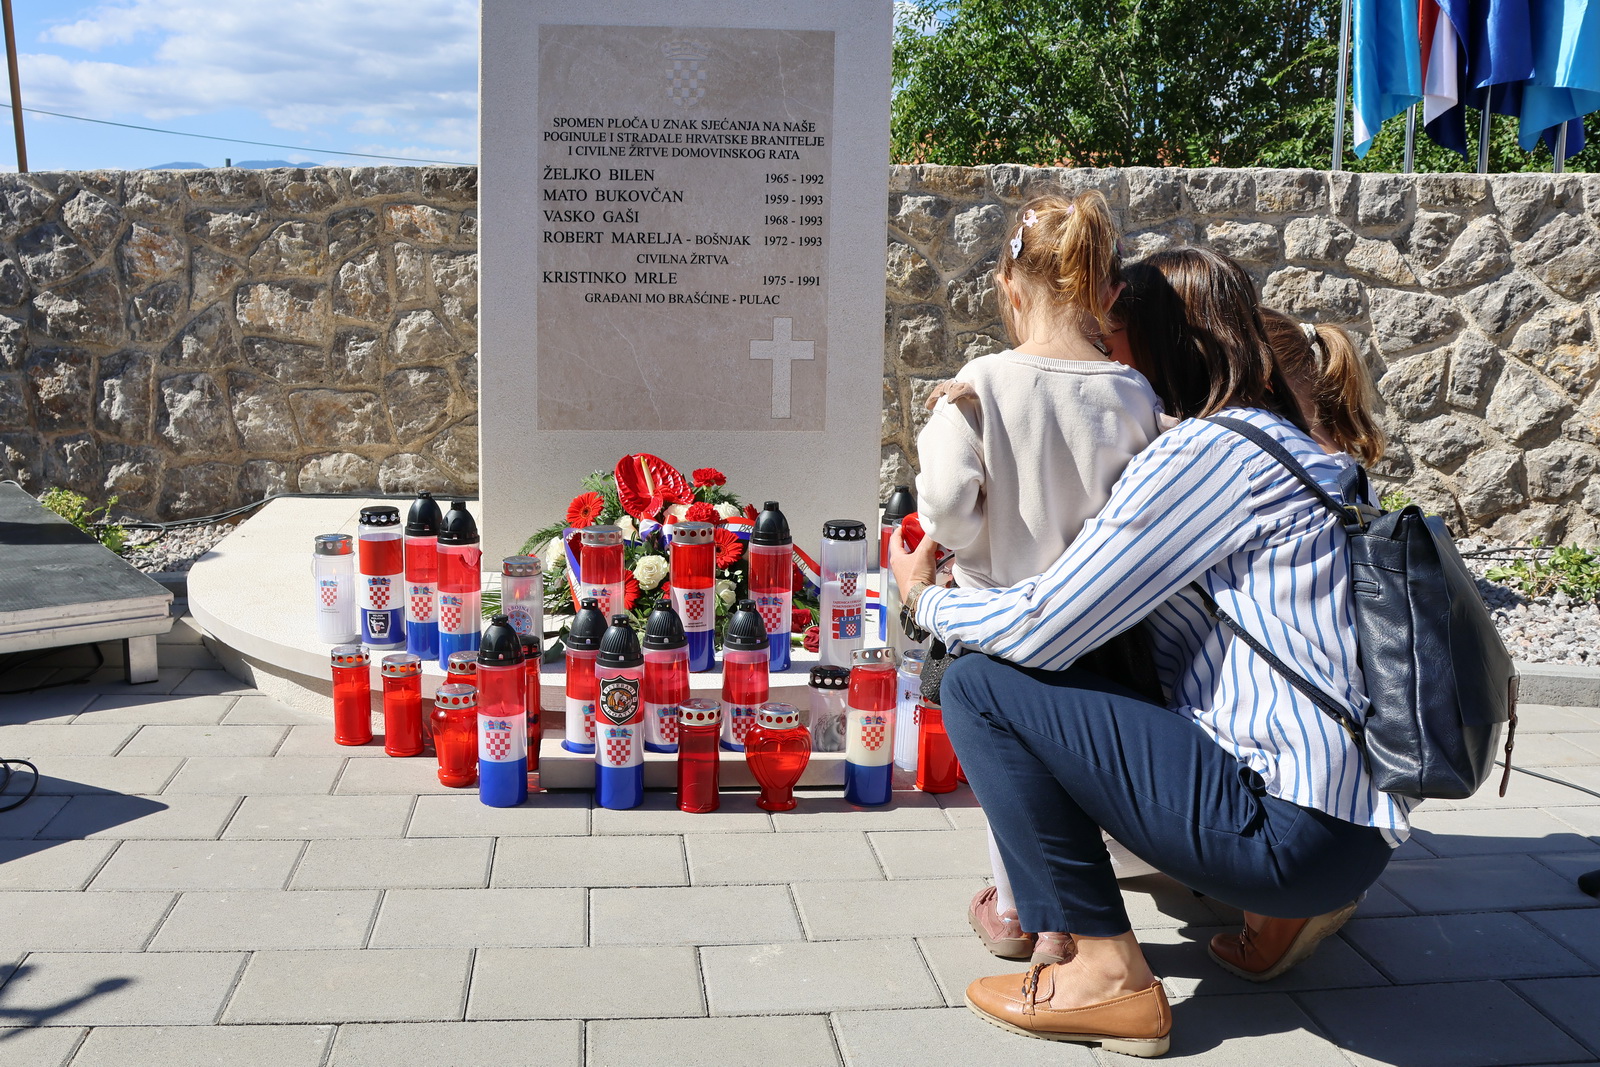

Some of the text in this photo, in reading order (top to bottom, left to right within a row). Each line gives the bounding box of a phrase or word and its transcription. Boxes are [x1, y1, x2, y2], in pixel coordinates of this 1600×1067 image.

[552, 115, 816, 133] SPOMEN PLOČA U ZNAK SJEĆANJA NA NAŠE
[543, 130, 825, 147] POGINULE I STRADALE HRVATSKE BRANITELJE
[567, 143, 801, 160] I CIVILNE ŽRTVE DOMOVINSKOG RATA
[542, 164, 655, 182] ŽELJKO BILEN
[765, 172, 790, 184] 1965
[800, 173, 825, 185] 1992
[542, 186, 684, 203] MATO BUKOVČAN
[765, 193, 790, 205] 1959
[799, 194, 824, 206] 1993
[542, 207, 640, 224] VASKO GAŠI
[764, 214, 789, 226] 1968
[799, 215, 823, 227] 1993
[542, 230, 605, 244] ROBERT
[610, 231, 684, 245] MARELJA
[695, 231, 752, 246] BOŠNJAK
[764, 235, 789, 247] 1972
[798, 236, 823, 247] 1993
[636, 251, 730, 265] CIVILNA ŽRTVA
[542, 270, 678, 285] KRISTINKO MRLE
[762, 275, 787, 286] 1975
[797, 275, 820, 287] 1991
[584, 292, 642, 304] GRAĐANI
[645, 293, 666, 304] MO
[667, 290, 730, 305] BRAŠĆINE
[739, 294, 781, 306] PULAC
[603, 683, 636, 694] VETERANI
